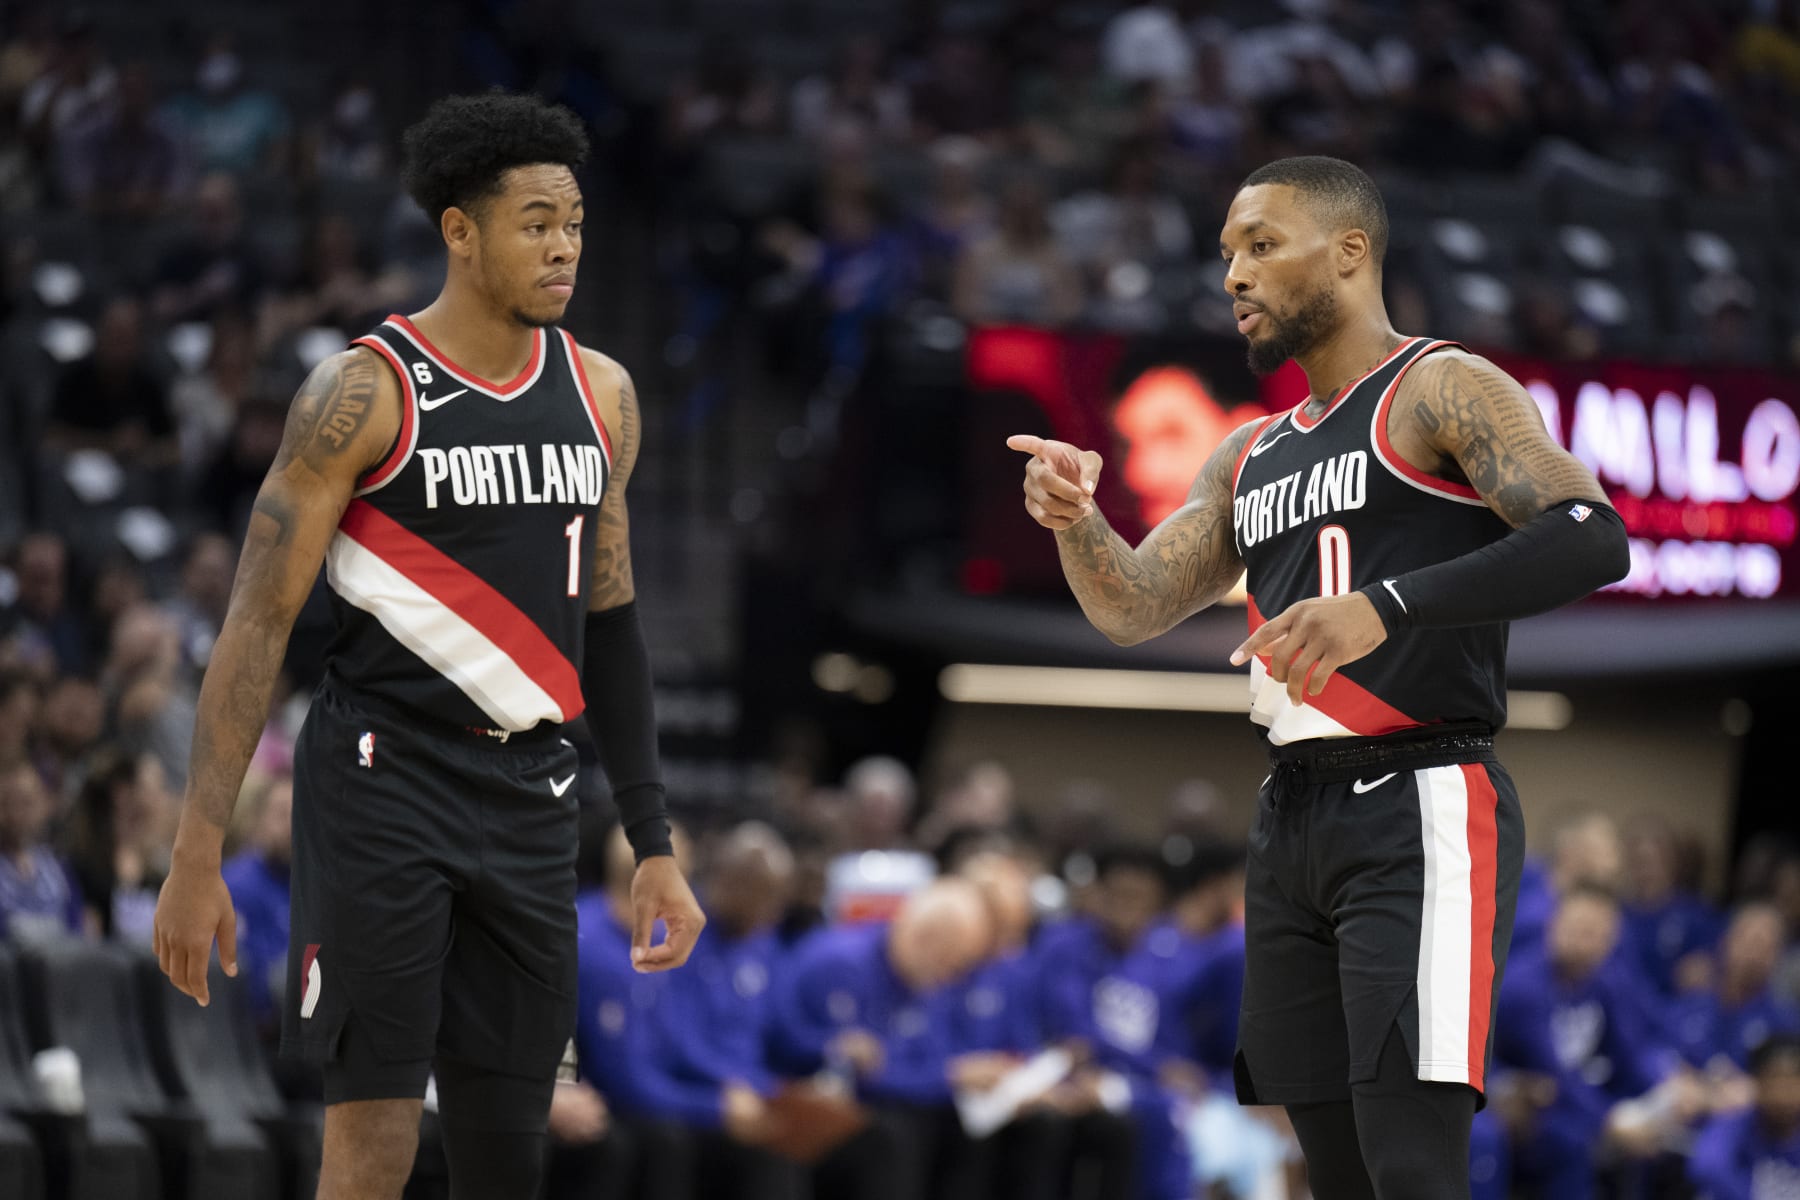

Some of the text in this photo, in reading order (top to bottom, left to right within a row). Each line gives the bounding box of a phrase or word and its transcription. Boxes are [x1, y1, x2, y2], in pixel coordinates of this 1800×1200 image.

[411, 362, 434, 385] 6
[416, 444, 601, 509] PORTLAND
[1233, 450, 1368, 557] PORTLAND
[564, 514, 584, 598] 1
[1317, 524, 1350, 598] 0
